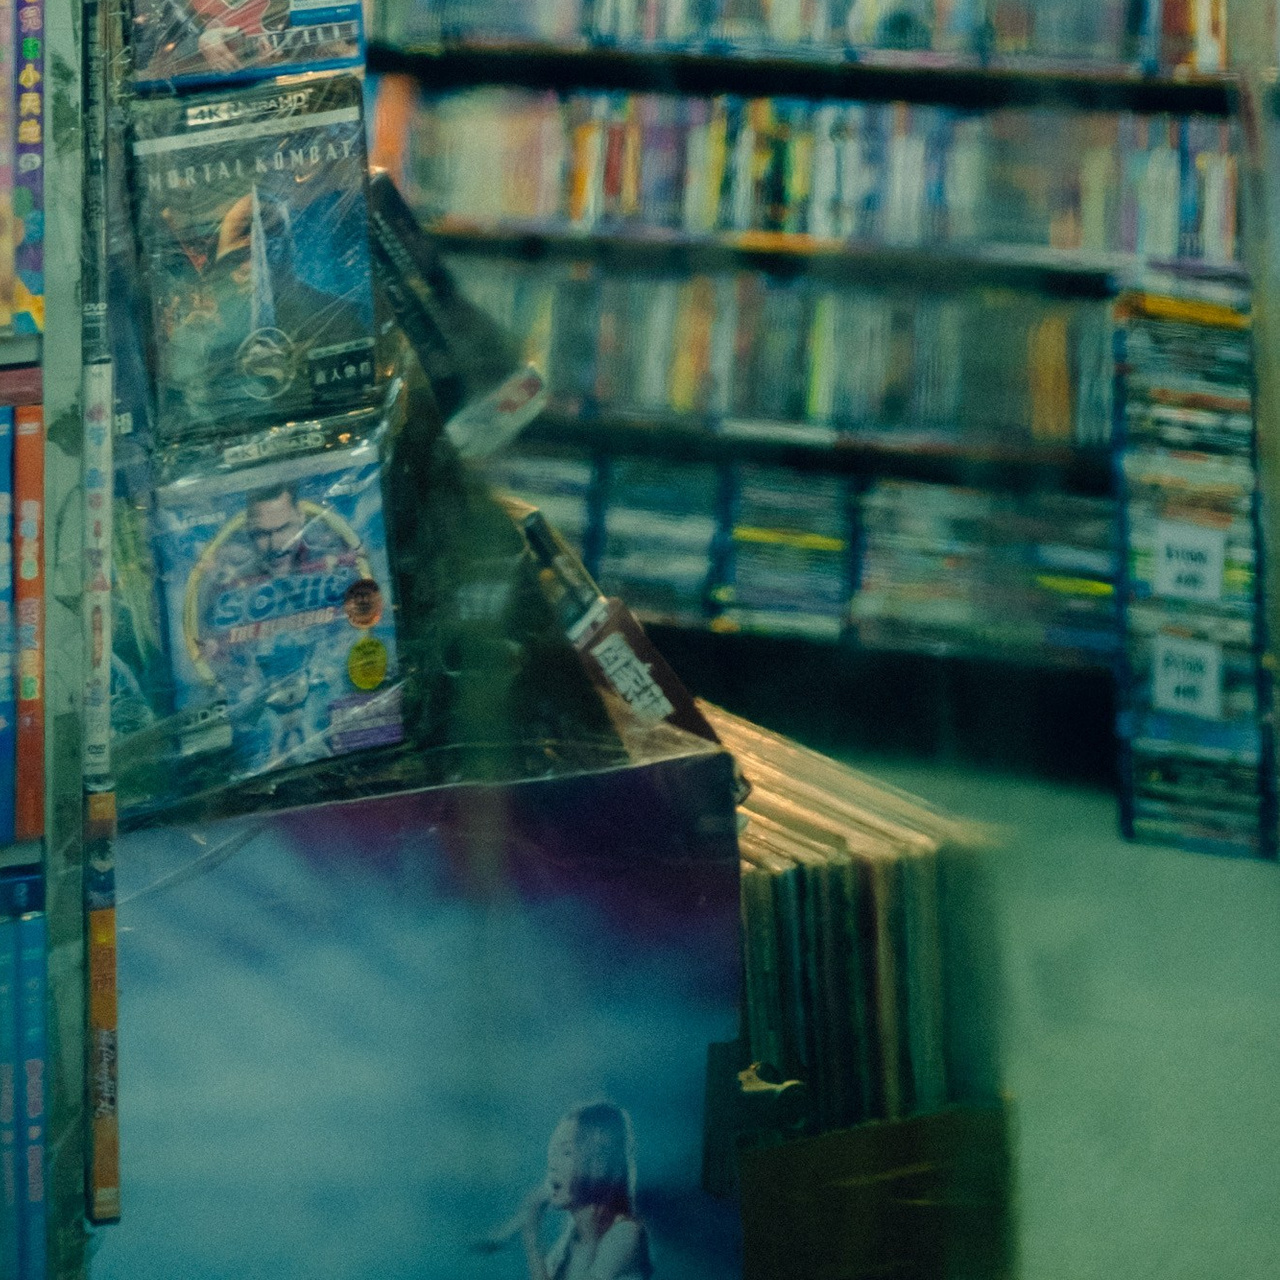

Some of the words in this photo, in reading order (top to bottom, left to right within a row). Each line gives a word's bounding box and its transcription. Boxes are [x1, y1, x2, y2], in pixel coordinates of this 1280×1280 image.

[18, 5, 43, 144] 兒歌小天地
[147, 159, 243, 192] MORTAL
[254, 141, 356, 174] KOMBAT
